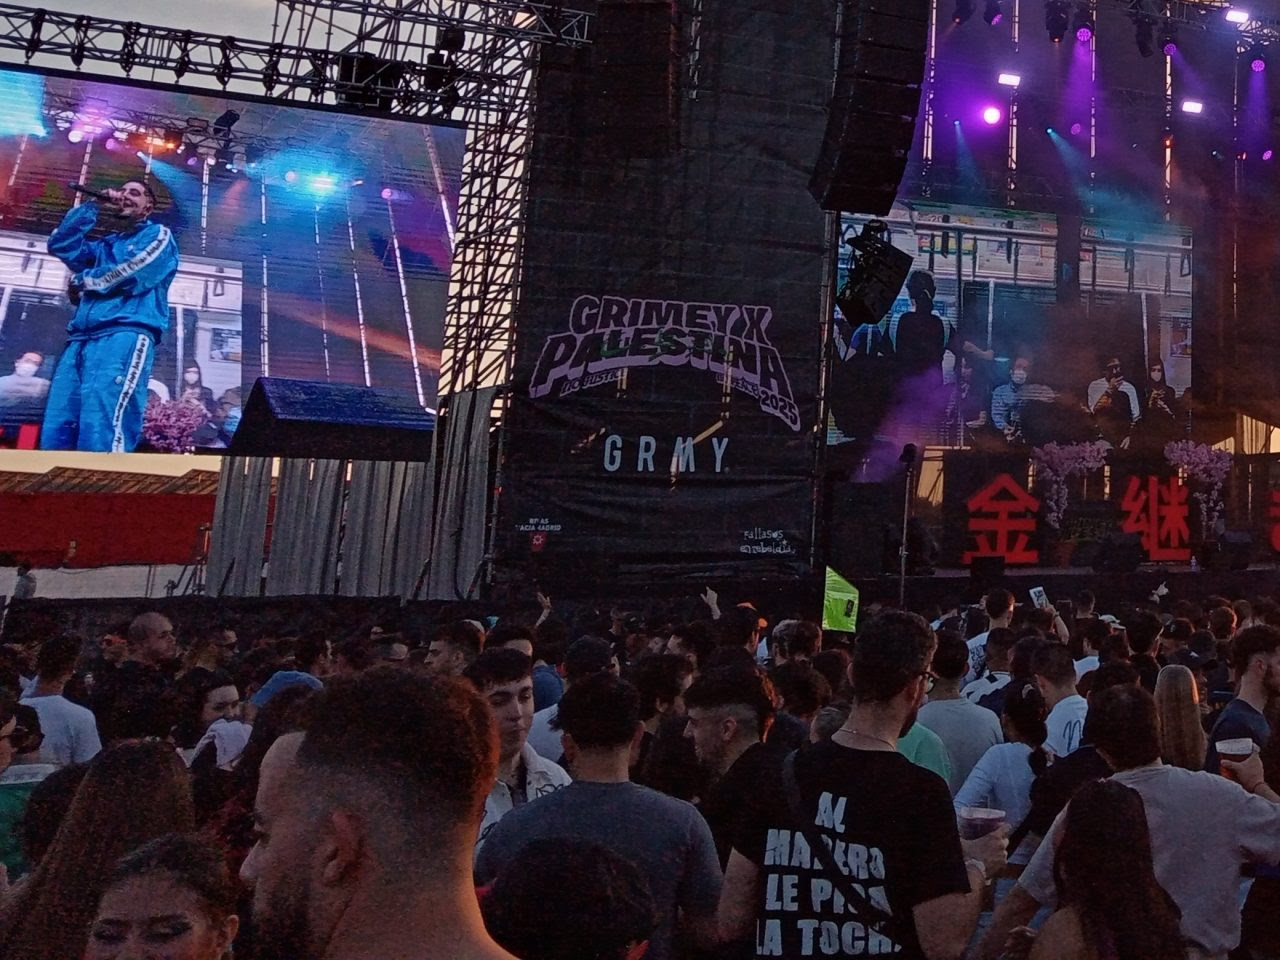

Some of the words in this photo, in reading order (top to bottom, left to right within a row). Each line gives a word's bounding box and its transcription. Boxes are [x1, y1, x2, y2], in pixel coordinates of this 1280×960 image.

[569, 294, 740, 336] GRIMEY
[738, 305, 774, 346] X
[528, 326, 796, 400] PALESTINA
[760, 386, 800, 431] 2025
[603, 435, 729, 473] GRMY
[815, 791, 848, 833] AL
[765, 874, 798, 911] LE
